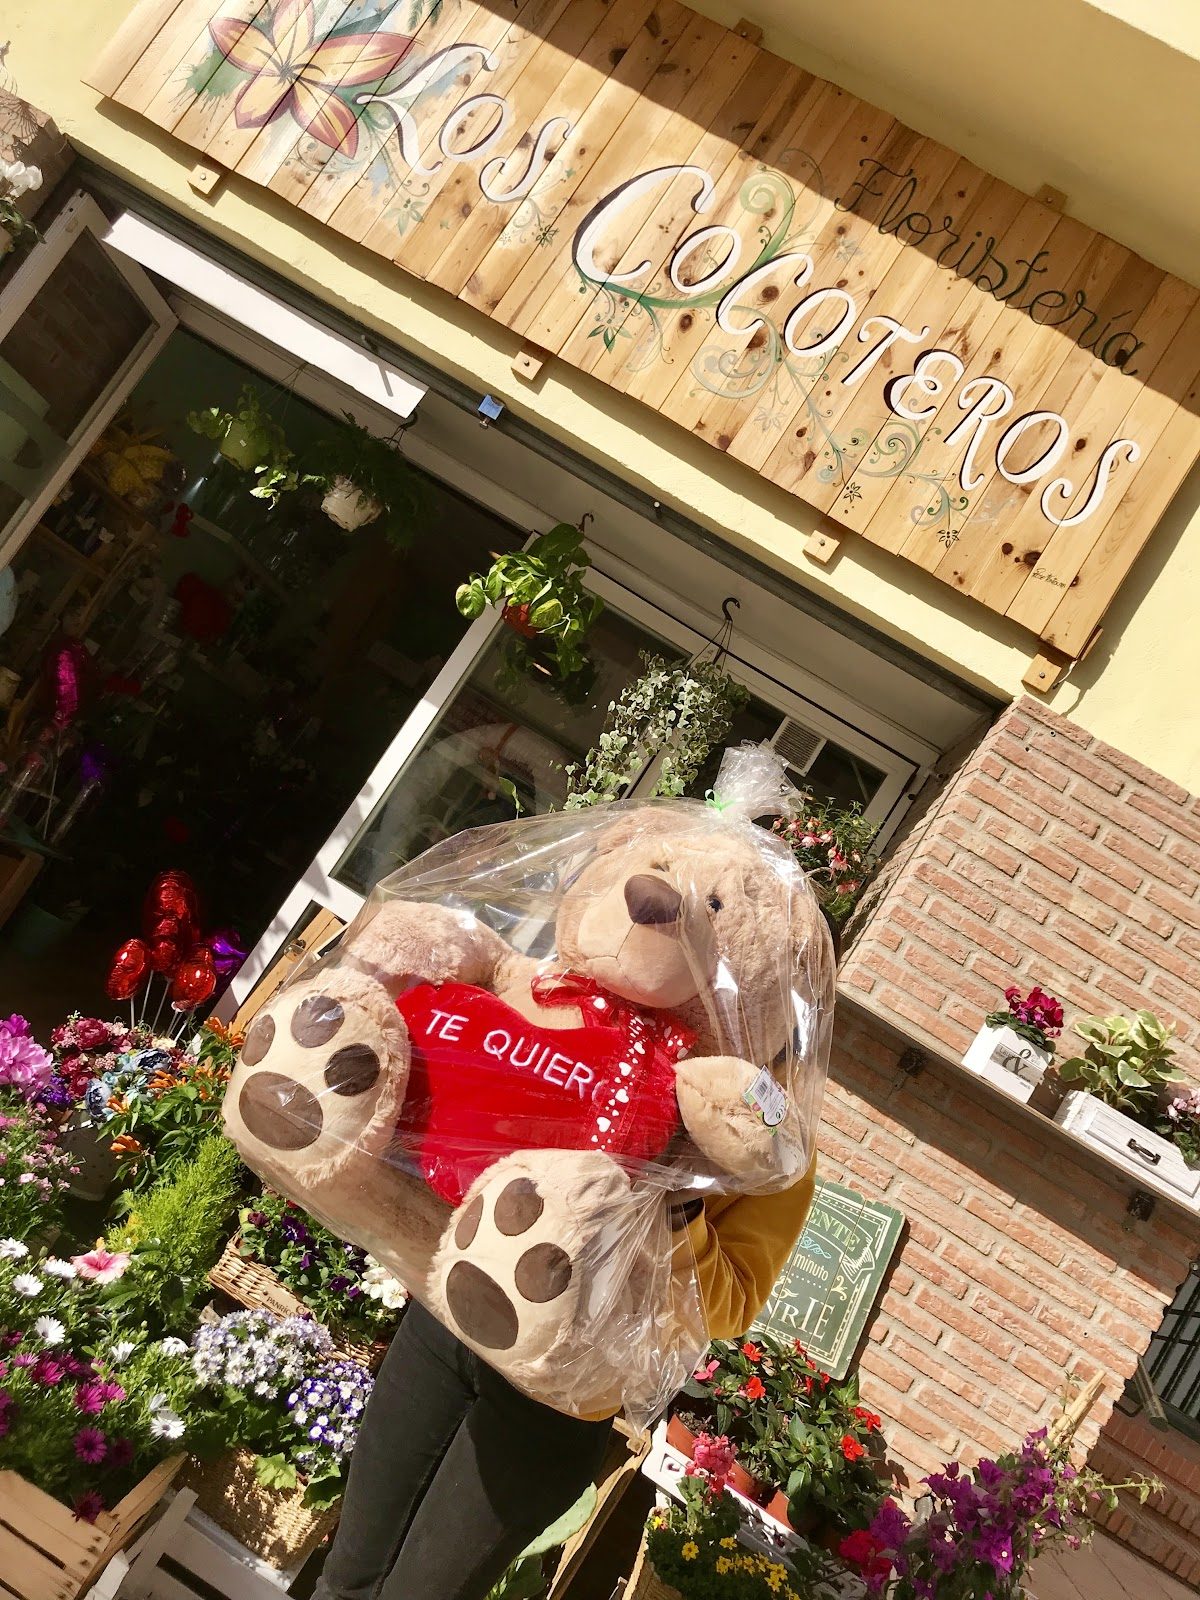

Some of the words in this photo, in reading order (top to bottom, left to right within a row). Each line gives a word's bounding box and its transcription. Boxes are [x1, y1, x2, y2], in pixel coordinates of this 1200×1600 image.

[834, 157, 1145, 378] Floristería
[425, 1008, 470, 1042] TE
[806, 1207, 861, 1253] ENTE
[791, 1253, 830, 1282] minuto
